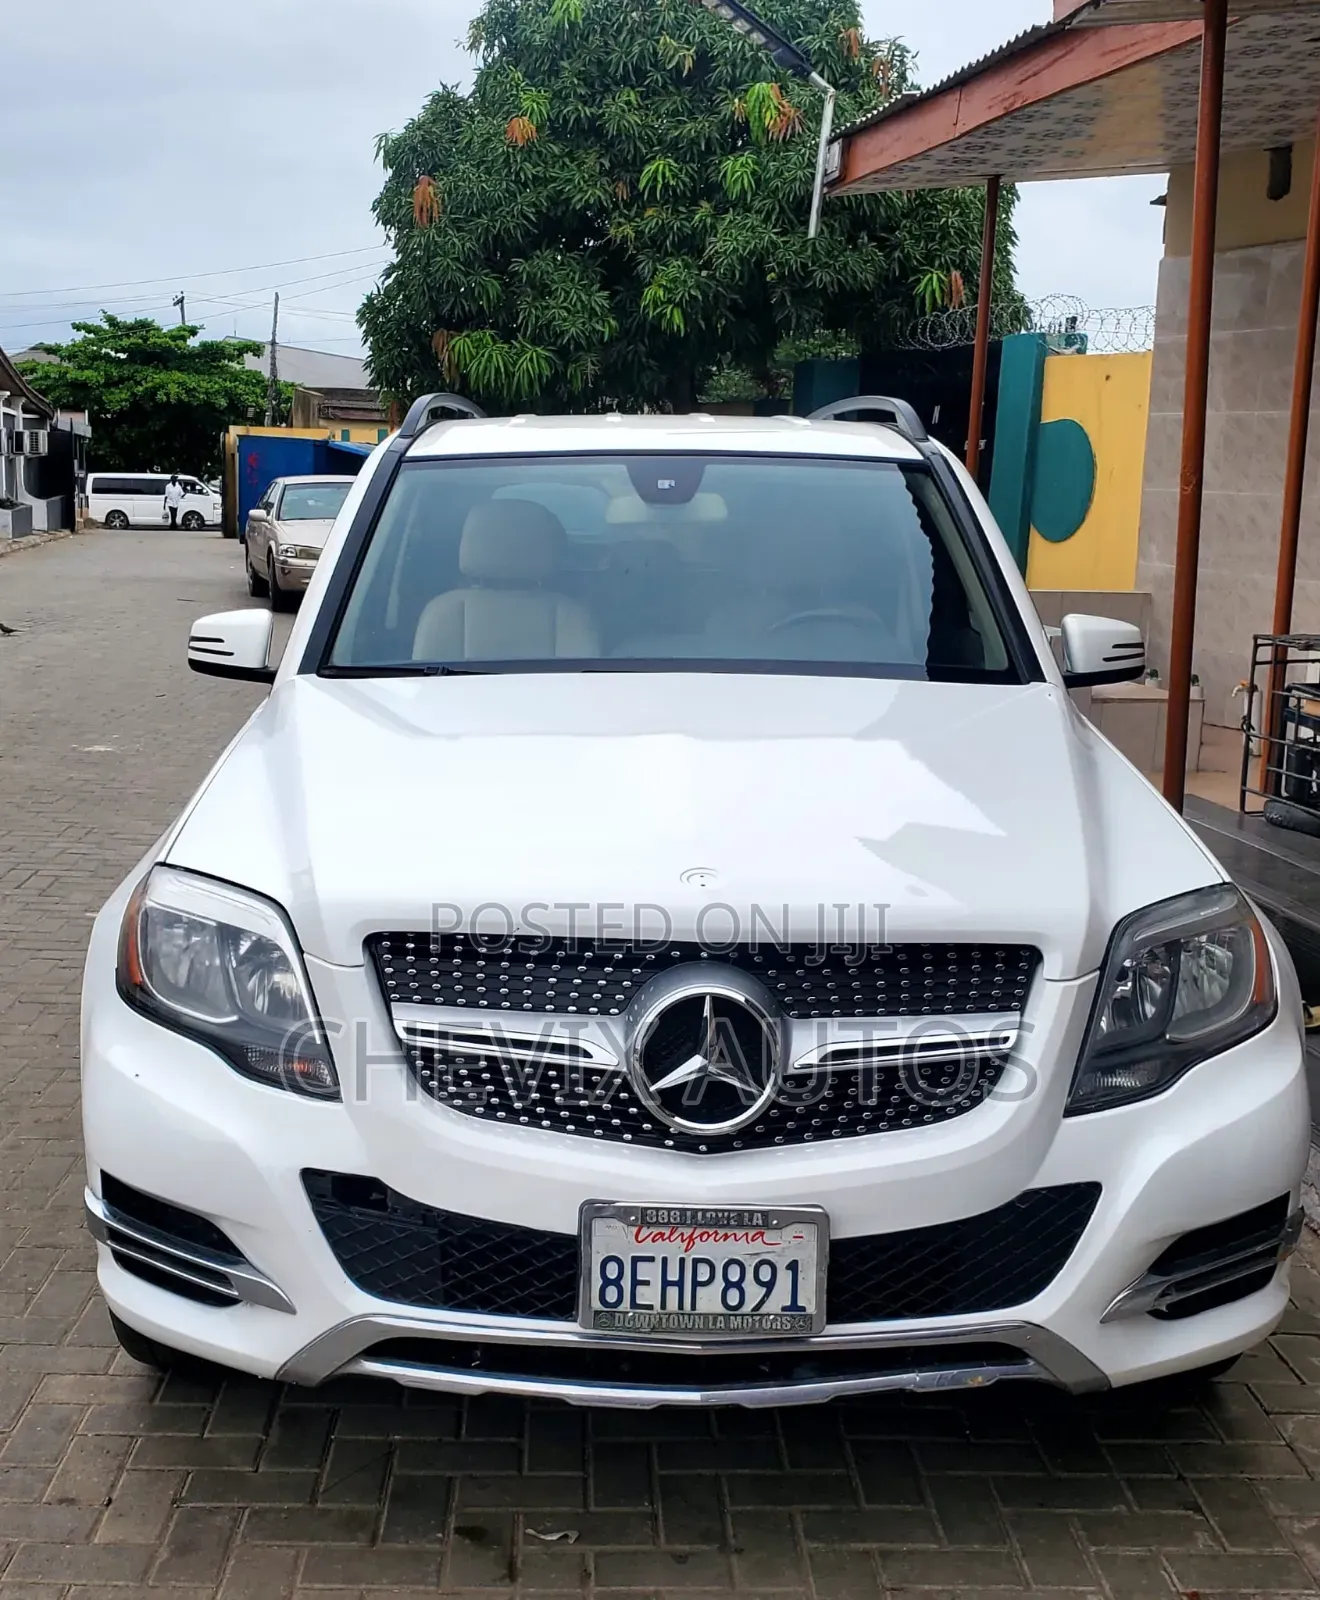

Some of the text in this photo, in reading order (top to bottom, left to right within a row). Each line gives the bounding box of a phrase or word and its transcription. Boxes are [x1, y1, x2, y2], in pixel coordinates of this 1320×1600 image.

[743, 1212, 763, 1226] LA
[634, 1224, 782, 1253] California
[598, 1254, 807, 1312] 8EHP891
[614, 1312, 791, 1331] DOWNTOWN LA MOTORS
